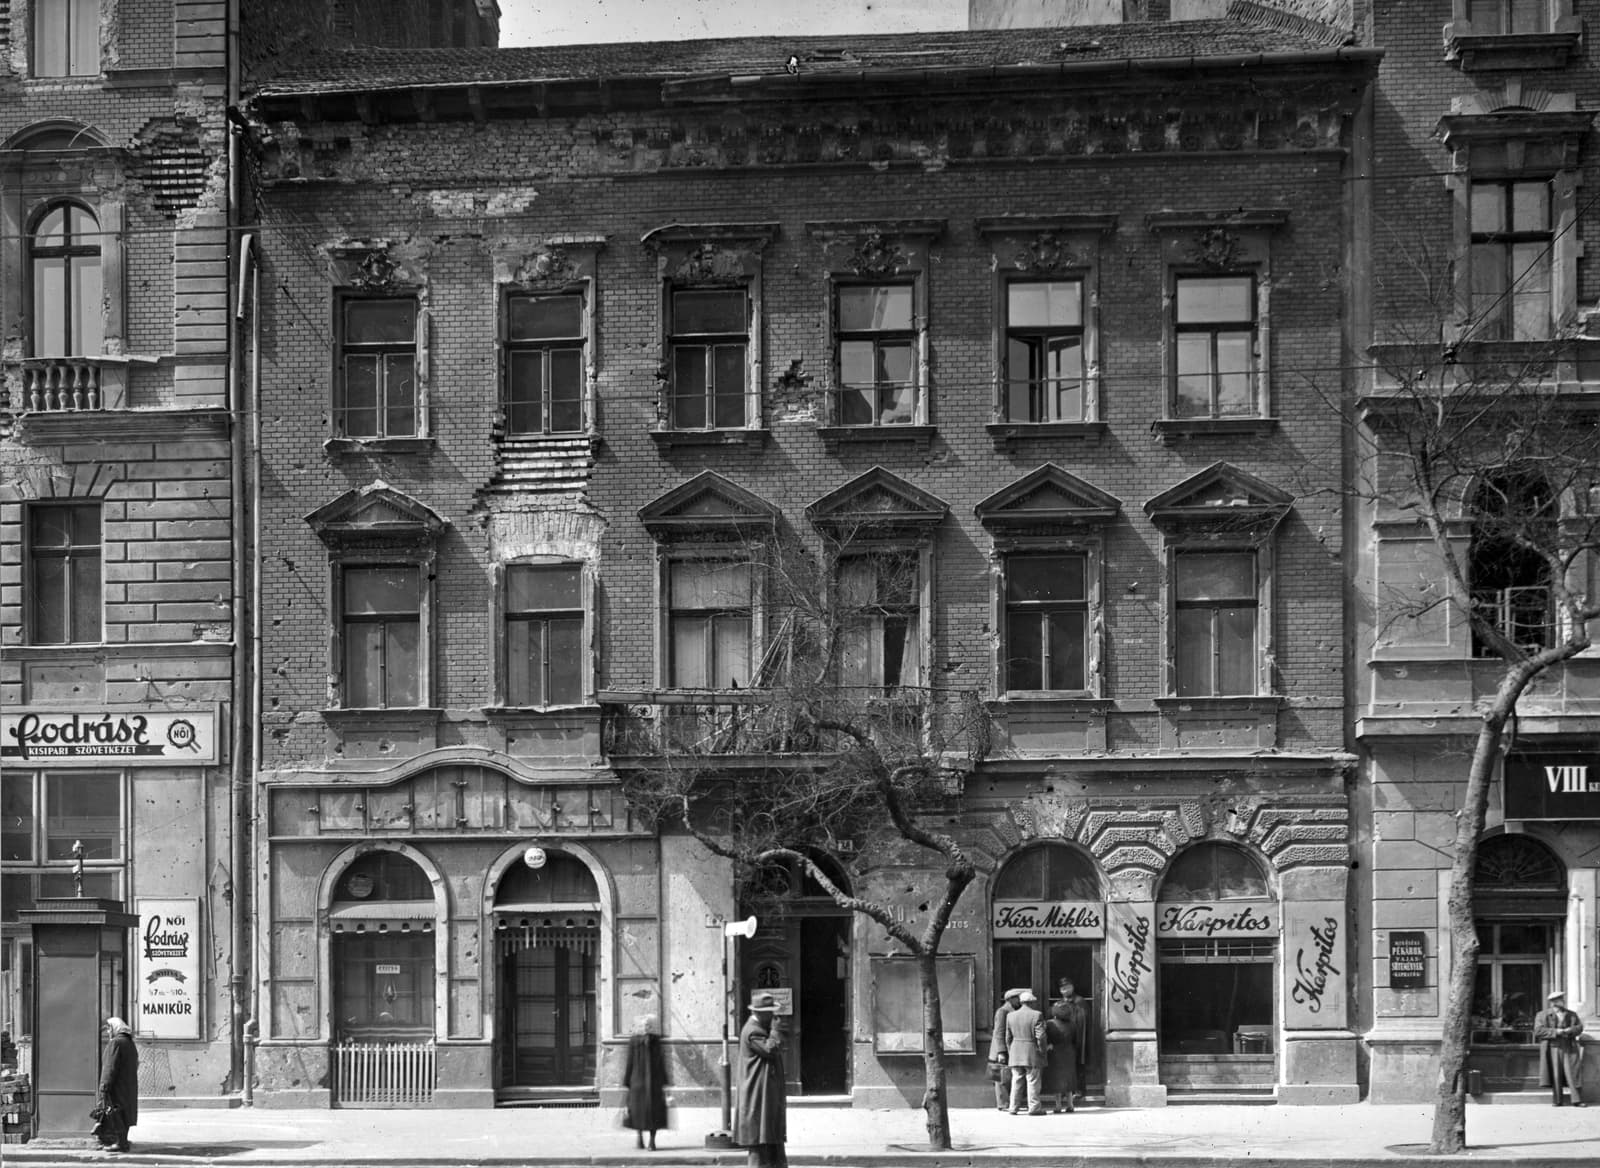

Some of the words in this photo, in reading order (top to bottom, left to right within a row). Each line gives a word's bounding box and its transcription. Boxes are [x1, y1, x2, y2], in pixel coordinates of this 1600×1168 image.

[173, 727, 189, 739] NŐI
[28, 746, 69, 756] KISIPARI
[75, 745, 137, 755] SZÖVETKEZET
[166, 915, 185, 926] NŐI
[995, 906, 1038, 928] Kiss
[1036, 906, 1100, 928] Miklós
[1159, 906, 1271, 937] Kárpitos
[1111, 915, 1152, 1014] Kárpitos
[1292, 916, 1341, 1014] Kárpitos
